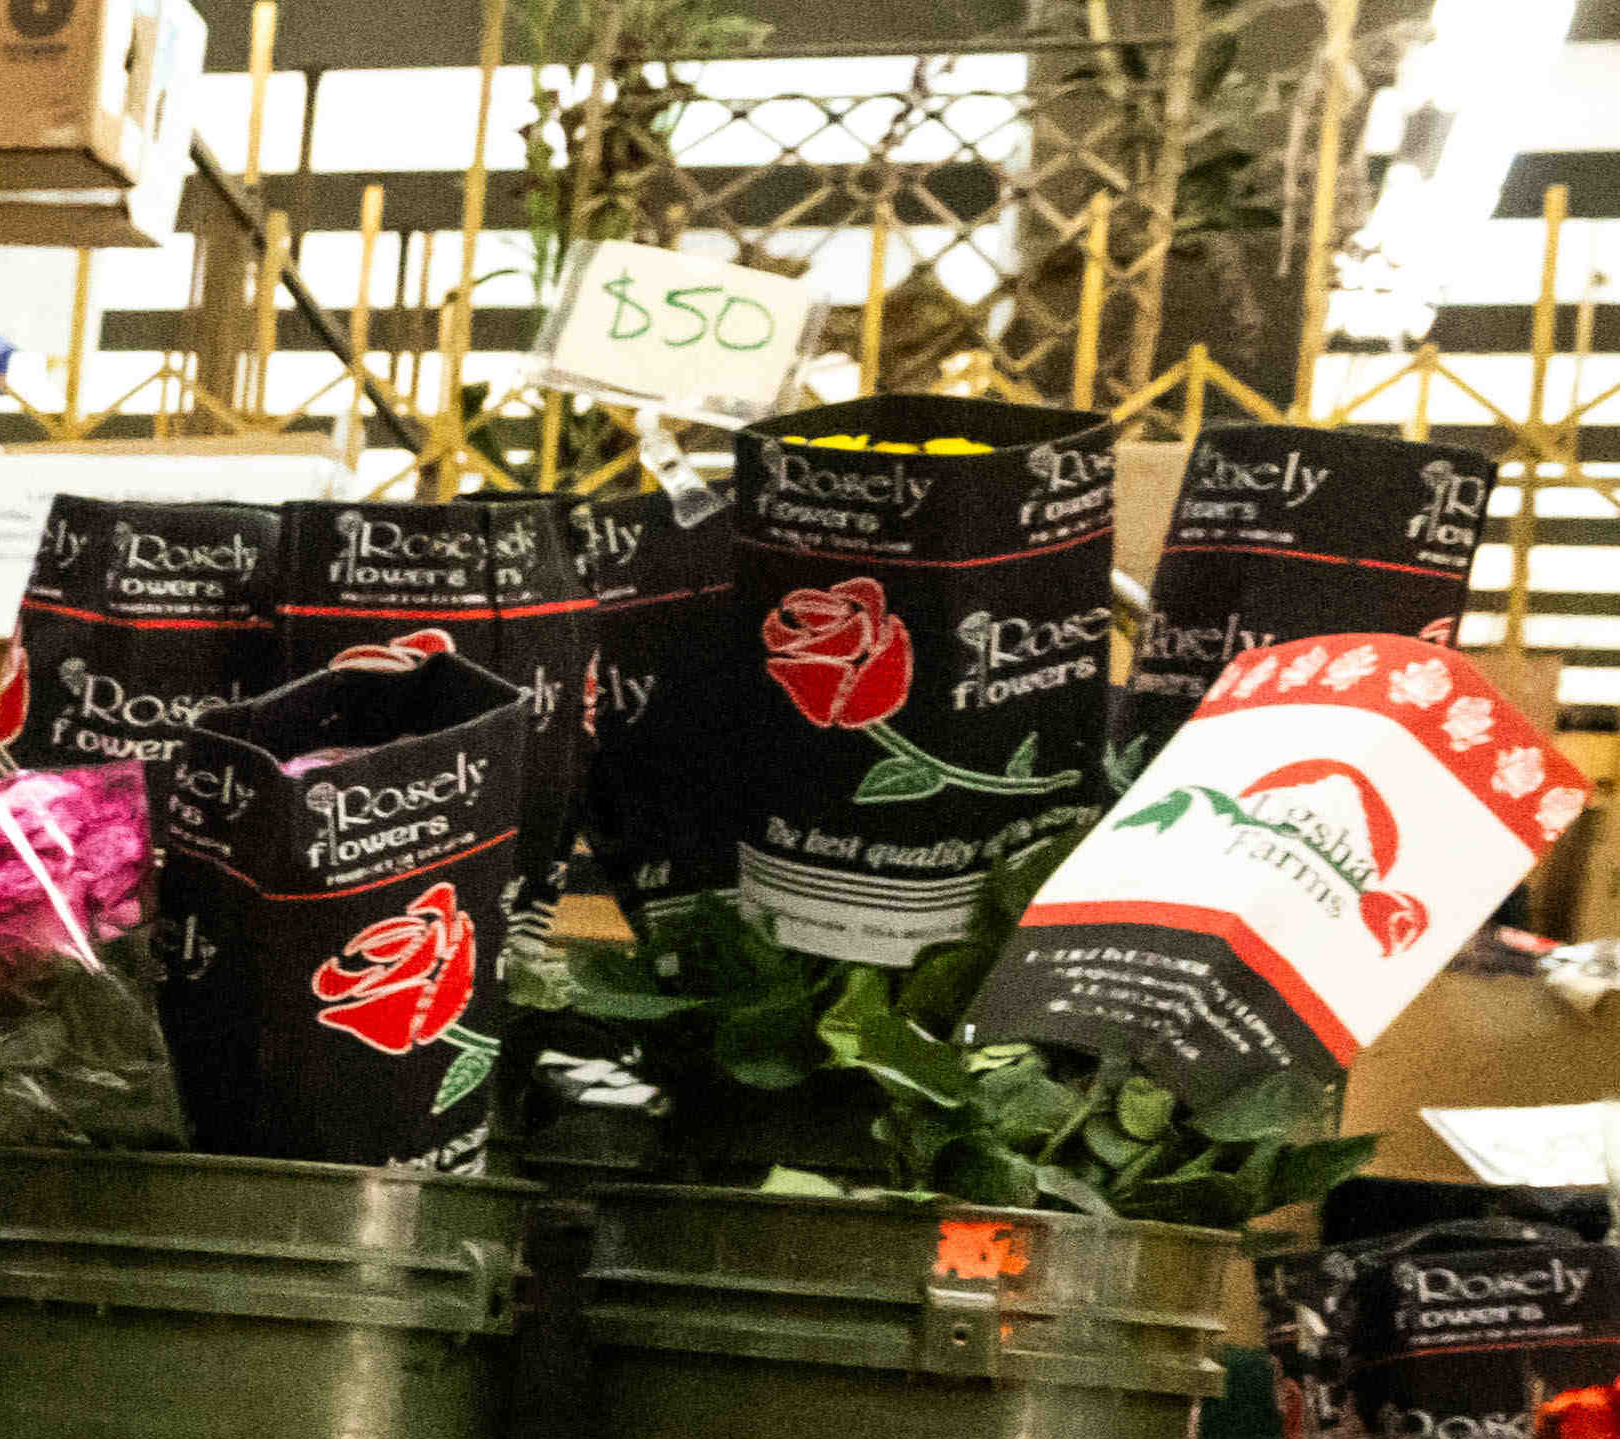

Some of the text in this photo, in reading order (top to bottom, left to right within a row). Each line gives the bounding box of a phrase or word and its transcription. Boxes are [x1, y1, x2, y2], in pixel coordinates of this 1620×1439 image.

[602, 266, 776, 352] $50
[778, 458, 934, 520] Rosely
[127, 530, 259, 584] Rosely
[987, 606, 1114, 670] Rose
[81, 672, 231, 728] Rose
[952, 656, 1098, 714] flowers
[52, 714, 185, 762] flower
[338, 750, 491, 834] Rosely
[308, 813, 452, 871] flowers
[803, 826, 862, 859] best
[1225, 828, 1344, 921] Farms
[1419, 1258, 1590, 1306] Rosely
